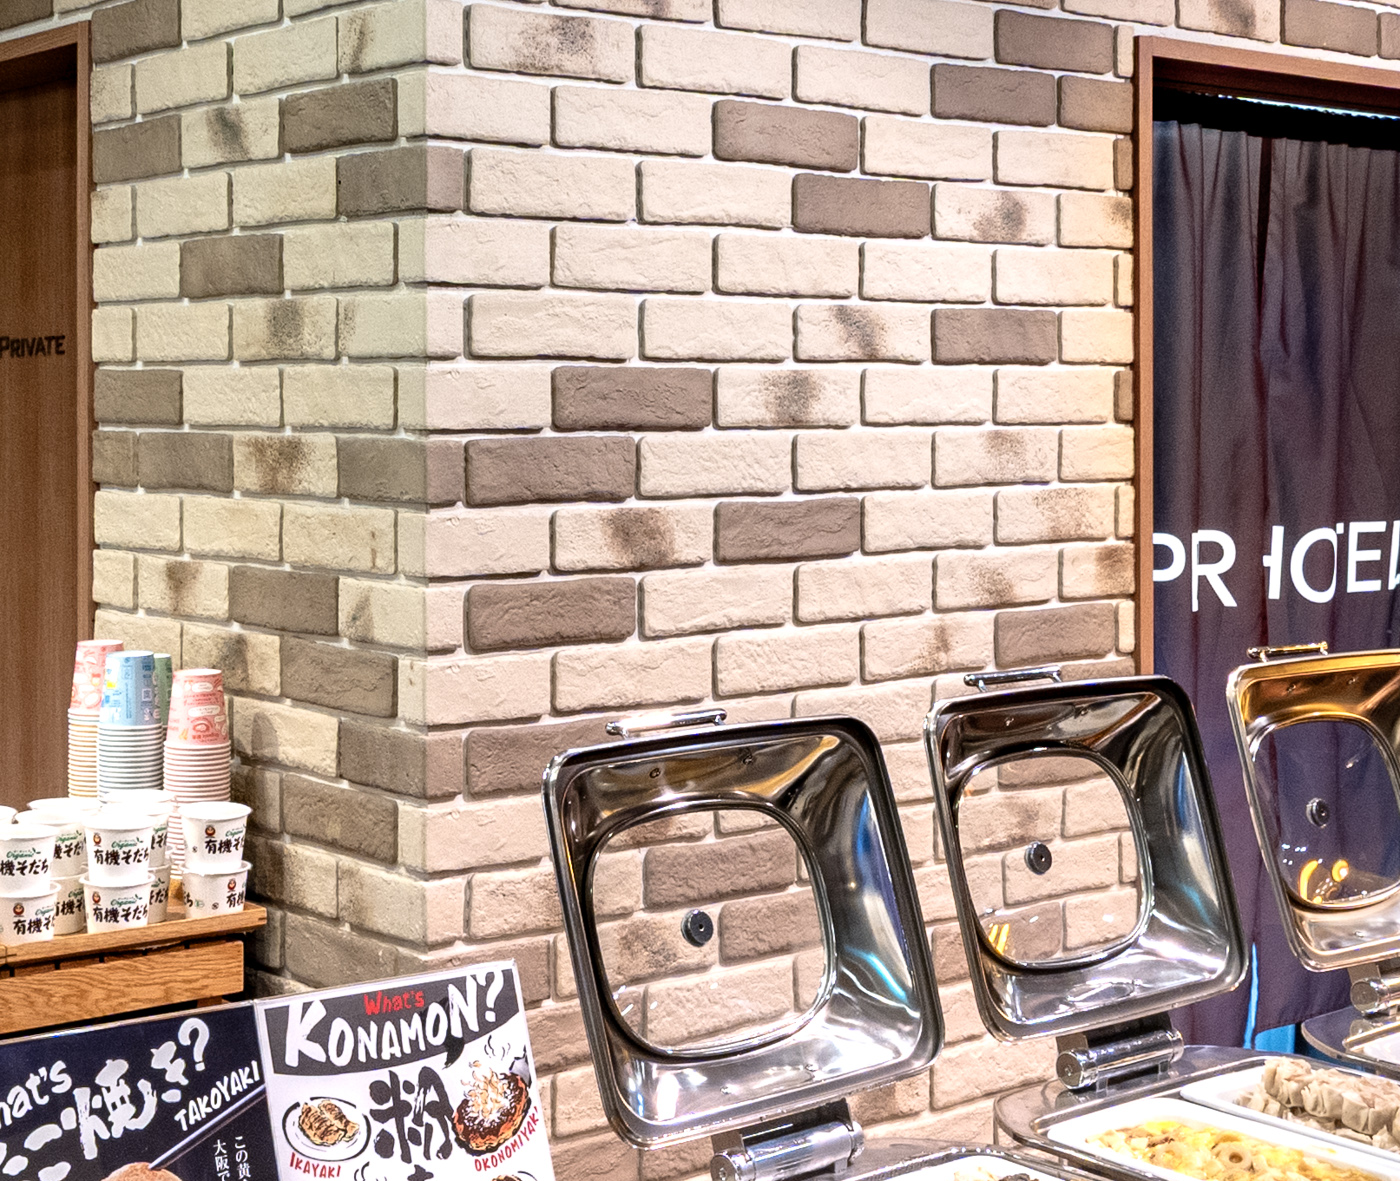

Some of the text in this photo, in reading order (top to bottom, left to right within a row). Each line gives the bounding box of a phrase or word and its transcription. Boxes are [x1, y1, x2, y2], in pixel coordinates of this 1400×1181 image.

[285, 970, 505, 1068] KONAMON?
[363, 990, 425, 1016] What's
[174, 1060, 261, 1132] TAKOYAKI
[289, 1152, 341, 1179] IKAYAKI
